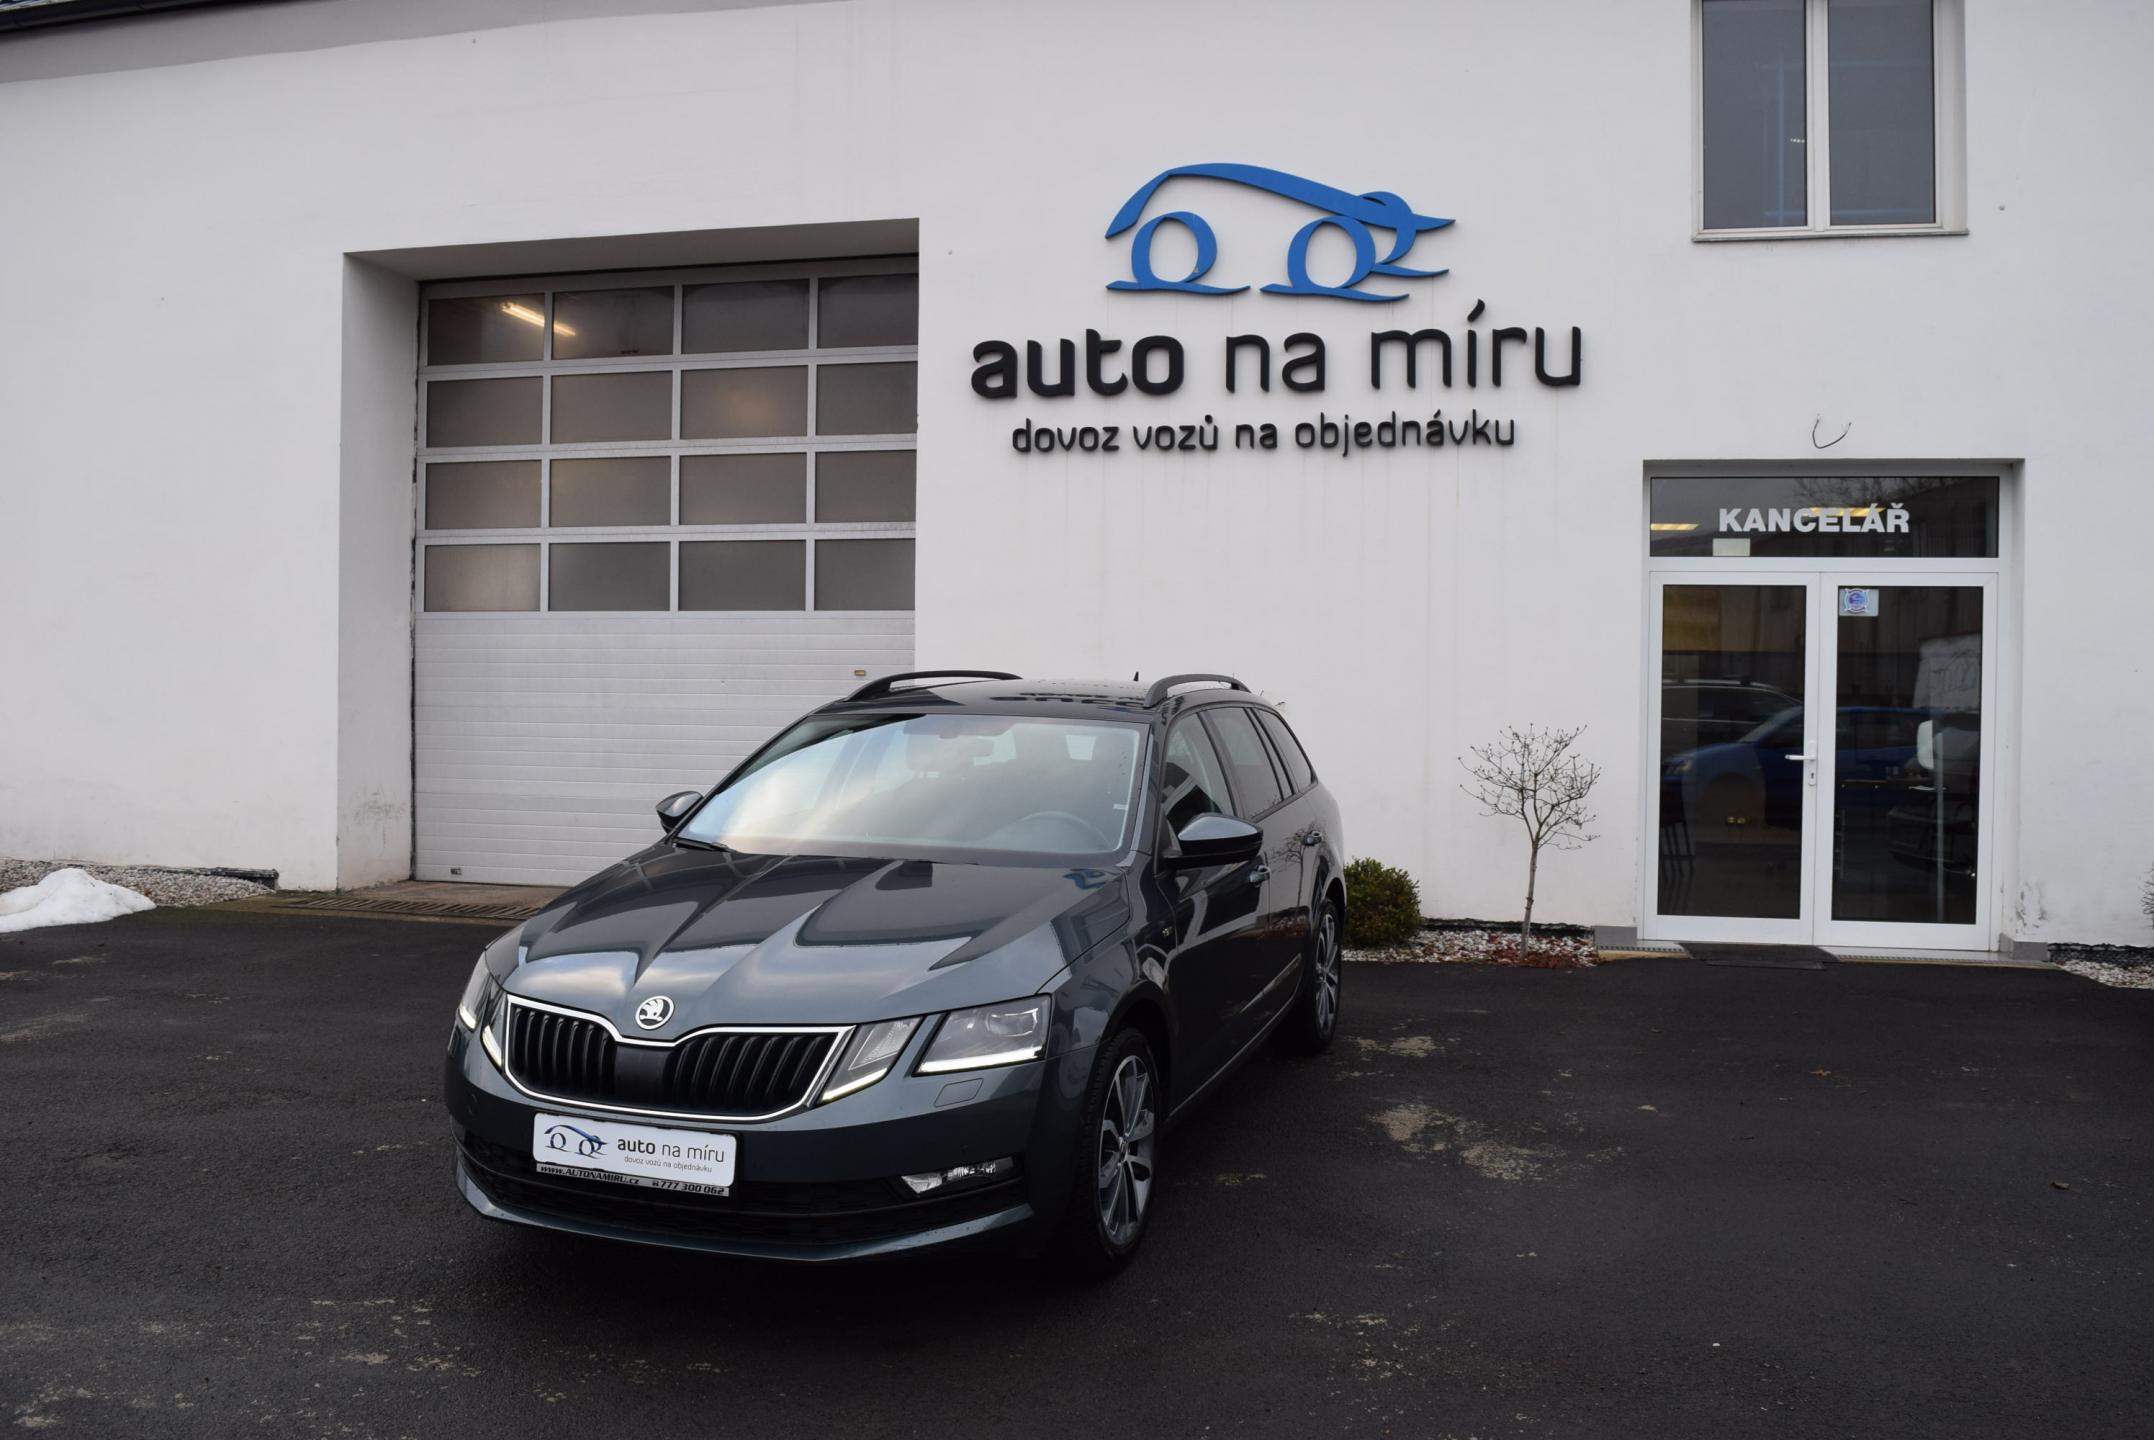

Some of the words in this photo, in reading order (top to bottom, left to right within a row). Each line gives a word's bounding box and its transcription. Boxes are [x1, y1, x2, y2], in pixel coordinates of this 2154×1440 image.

[971, 328, 1184, 399] auto
[1225, 331, 1326, 393] na
[1371, 299, 1582, 389] míru
[1012, 417, 1120, 454] dovoz
[1133, 414, 1219, 452] vozů
[1235, 422, 1278, 450] na
[1295, 409, 1516, 458] objednávku
[1718, 502, 1910, 534] KANCELÁŘ
[617, 1138, 656, 1155] auto
[661, 1144, 681, 1158] na
[687, 1144, 725, 1163] míru
[624, 1155, 644, 1165] dovoz
[662, 1161, 672, 1169] na
[673, 1162, 713, 1173] objednávku
[660, 1180, 680, 1190] 777
[681, 1183, 702, 1193] 300
[703, 1186, 725, 1195] 062
